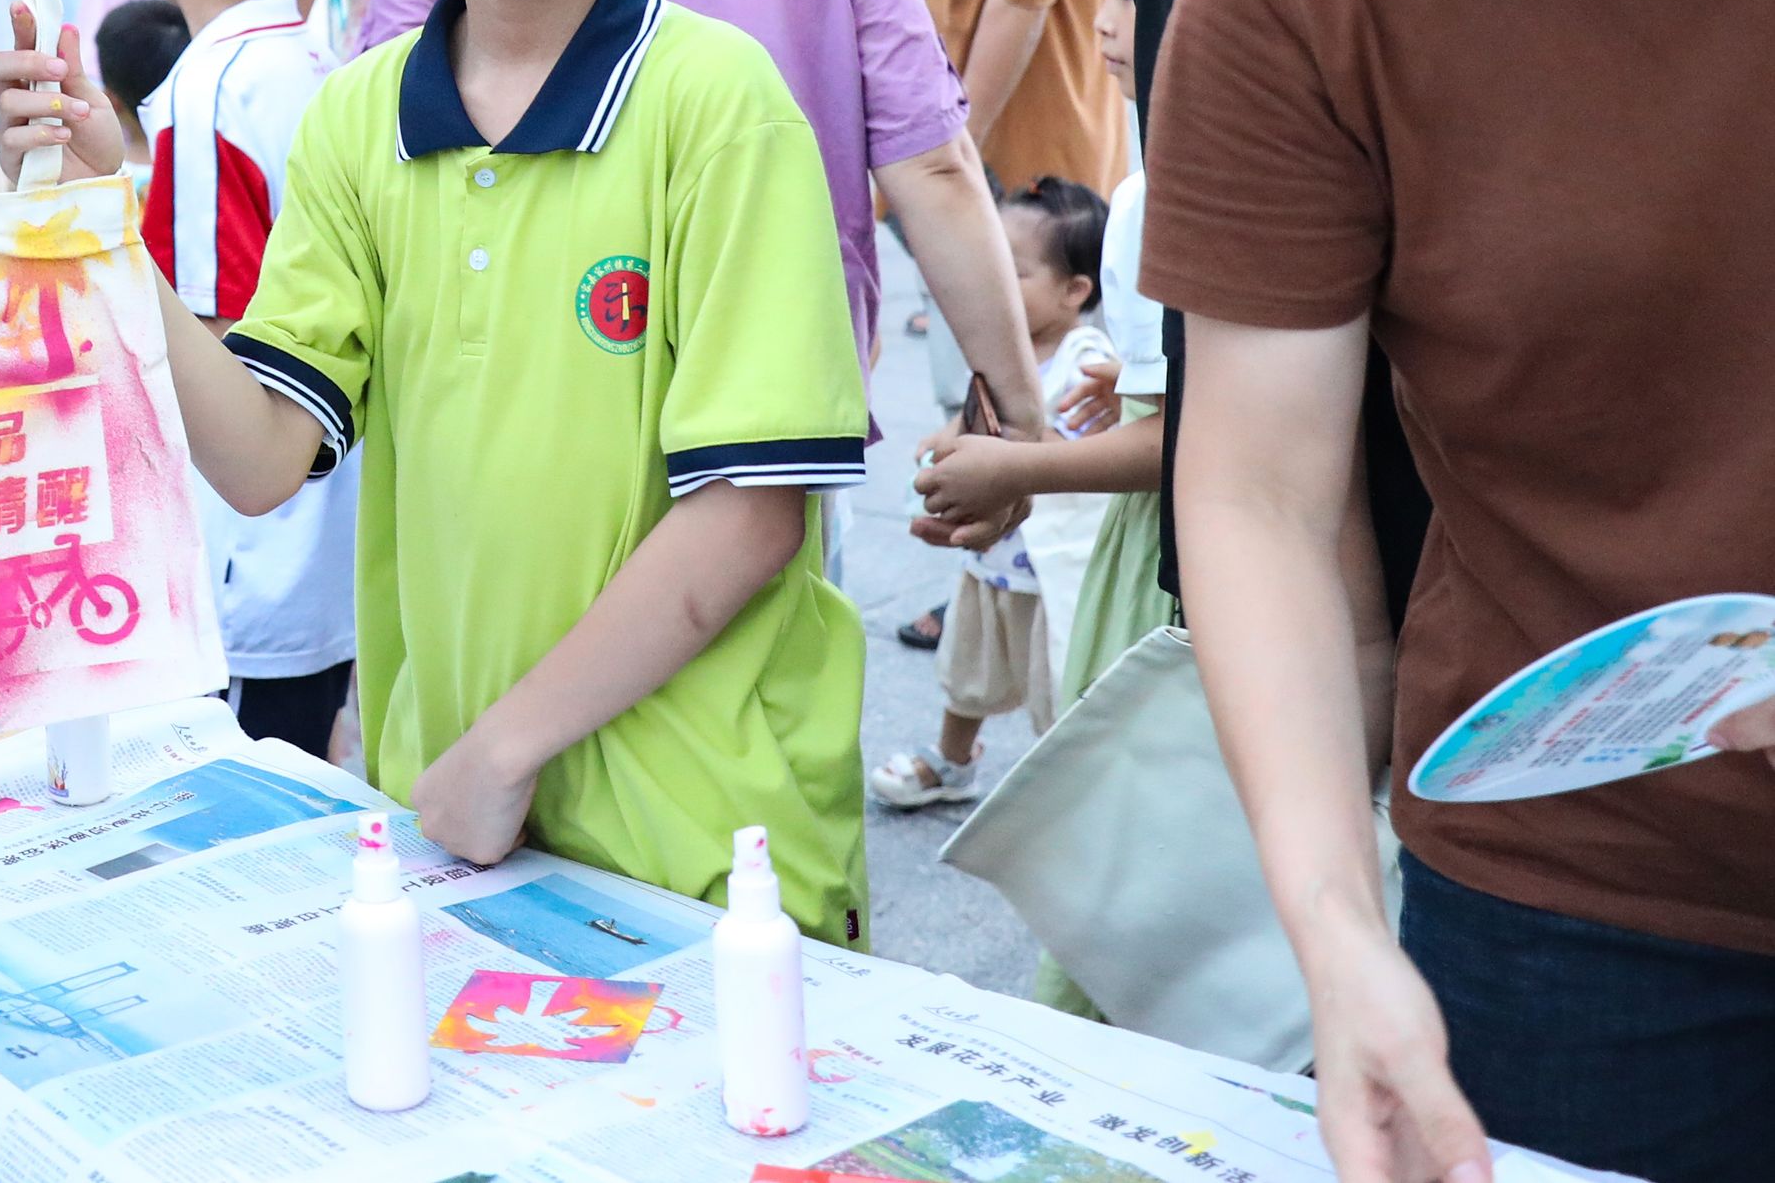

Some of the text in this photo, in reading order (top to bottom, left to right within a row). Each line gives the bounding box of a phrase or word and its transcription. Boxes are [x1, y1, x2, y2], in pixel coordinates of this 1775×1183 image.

[895, 1032, 1067, 1108] 发展花卉产业
